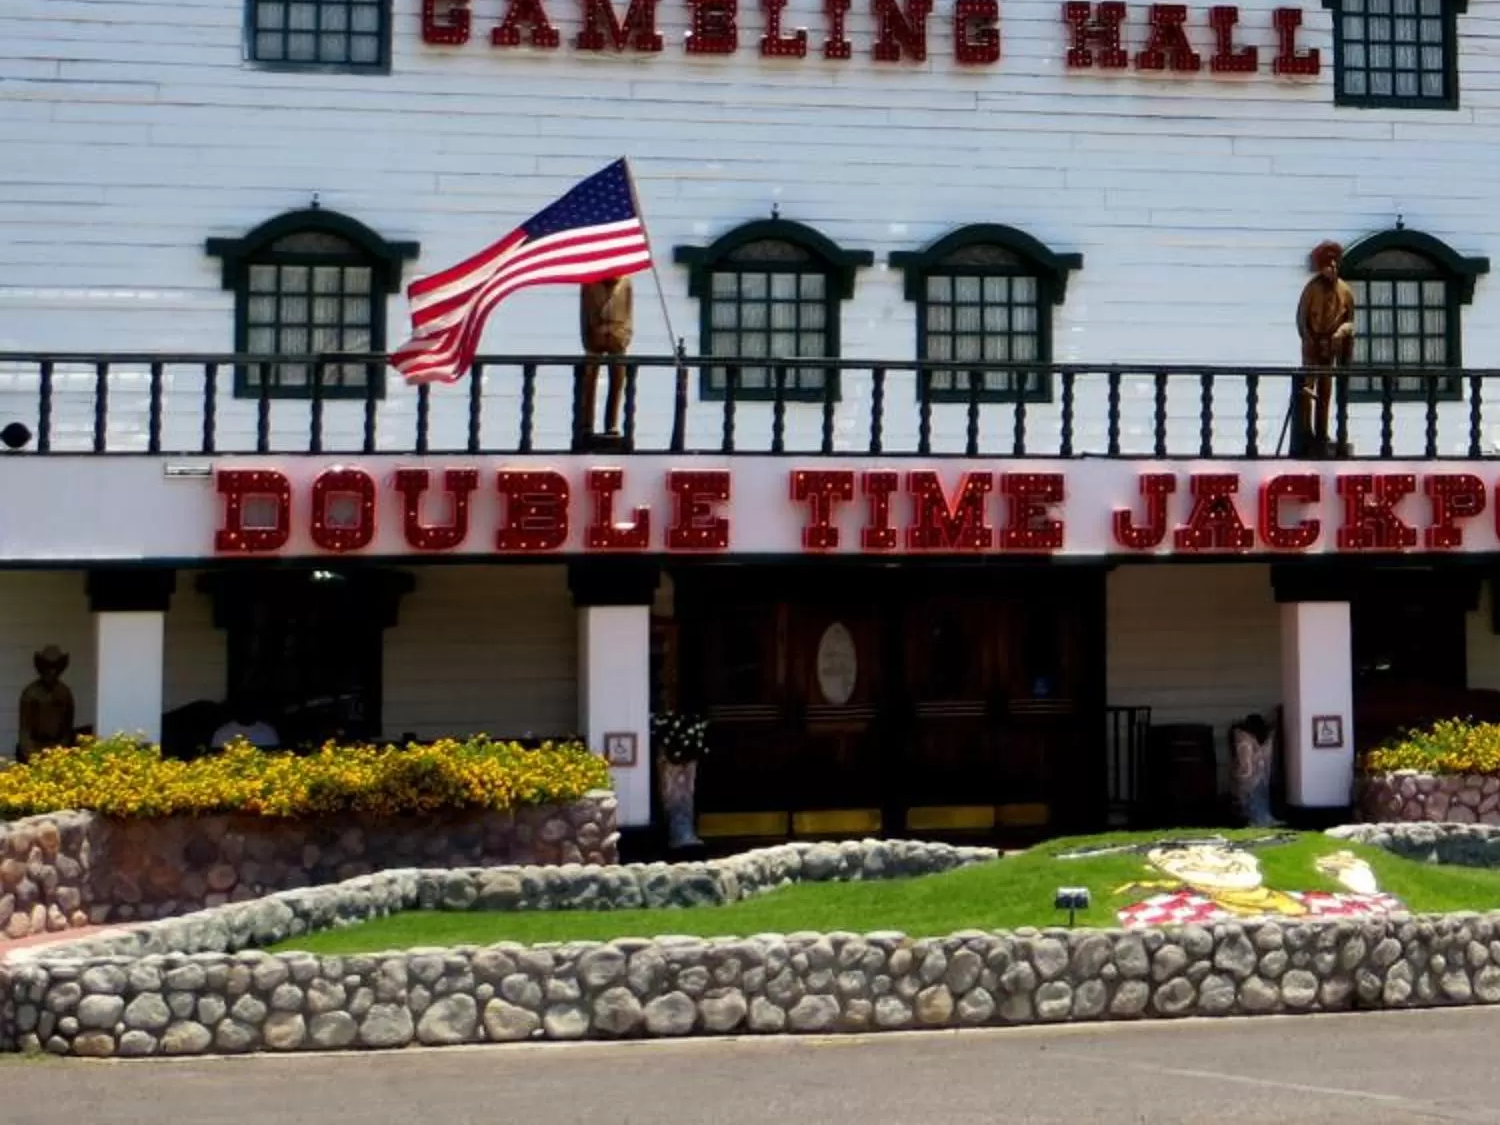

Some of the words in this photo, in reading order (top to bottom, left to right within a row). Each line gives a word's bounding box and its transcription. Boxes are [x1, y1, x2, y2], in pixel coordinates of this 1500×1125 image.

[1062, 1, 1321, 75] HALL
[215, 467, 732, 553] DOUBLE
[790, 469, 1064, 553] TIME
